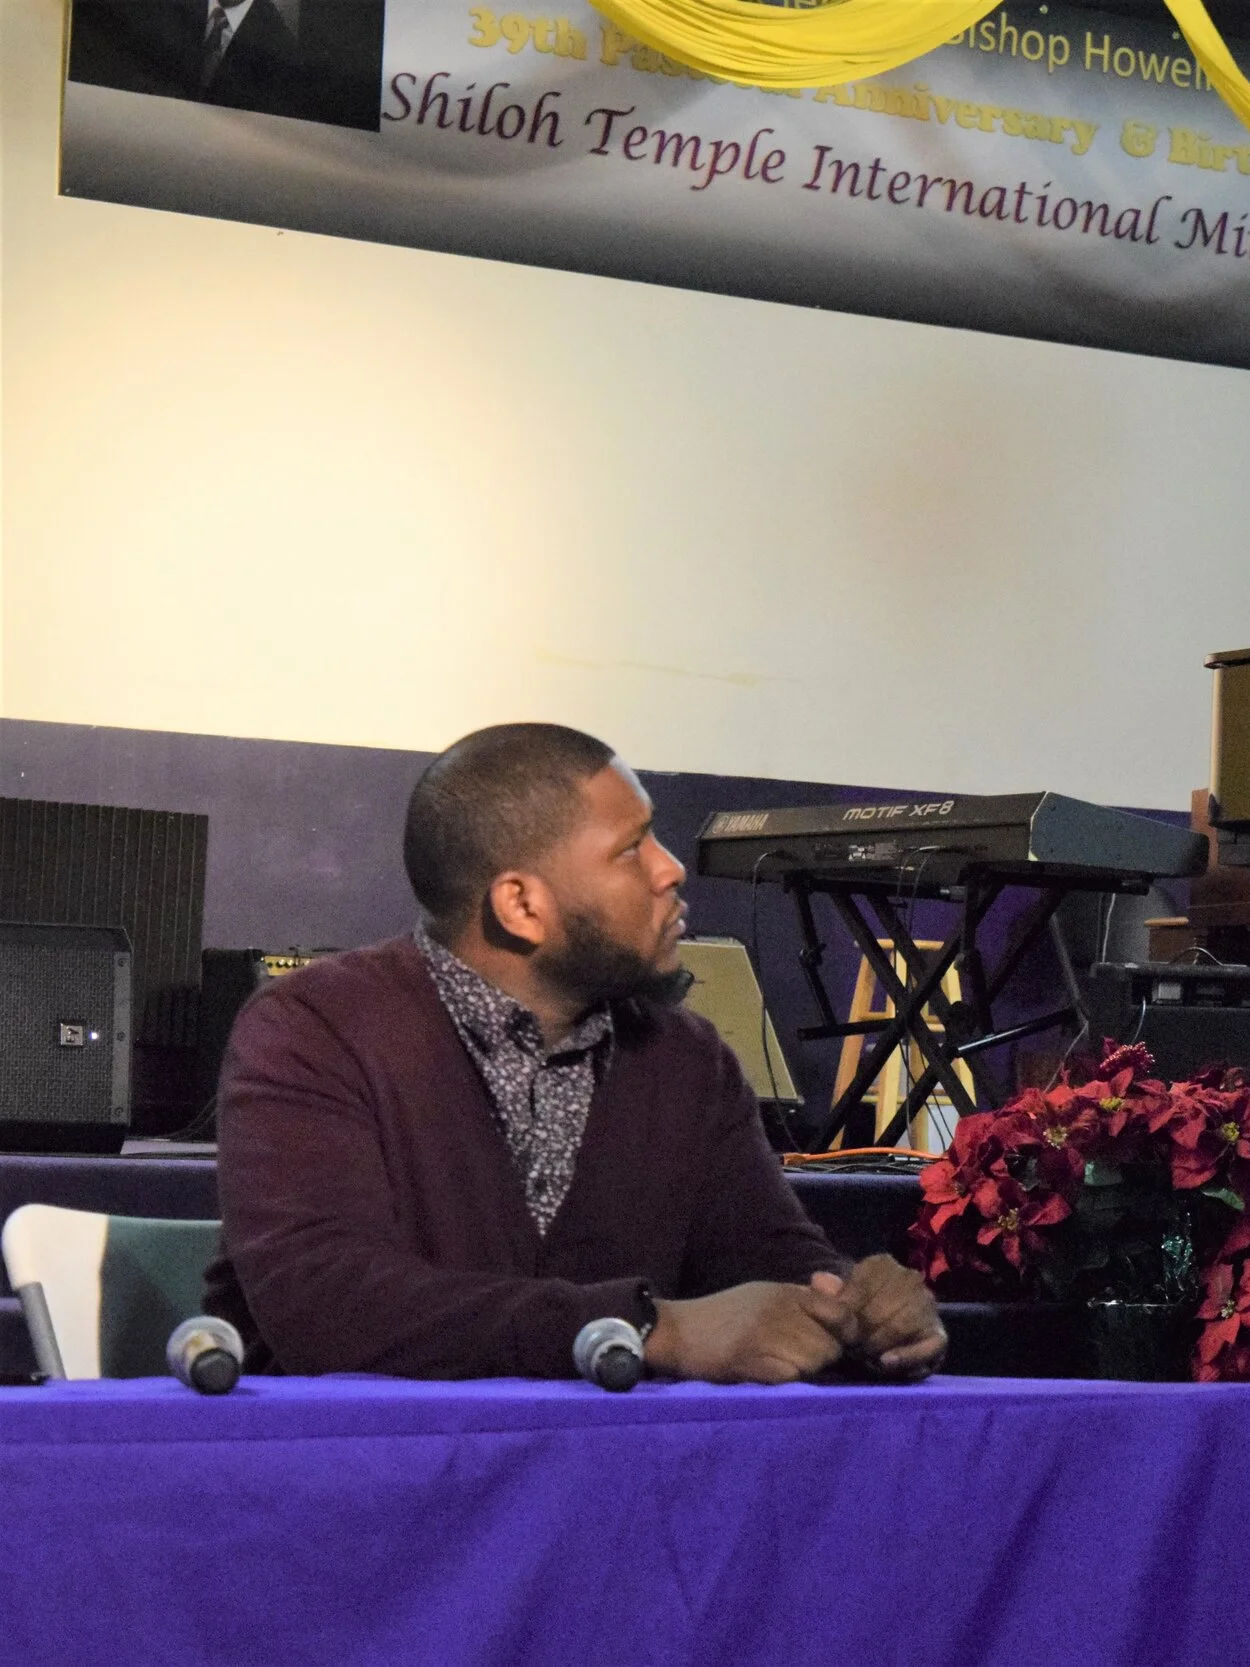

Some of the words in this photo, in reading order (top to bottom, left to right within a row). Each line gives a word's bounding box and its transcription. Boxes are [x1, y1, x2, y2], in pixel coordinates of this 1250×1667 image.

[467, 6, 586, 60] 39th
[812, 82, 1099, 155] Anniversary
[1119, 119, 1158, 158] &
[383, 72, 563, 147] Shiloh
[584, 105, 786, 190] Temple
[803, 144, 1172, 245] International
[726, 813, 769, 831] YAMAHA
[843, 805, 907, 821] MOTIF
[909, 800, 955, 817] XF8
